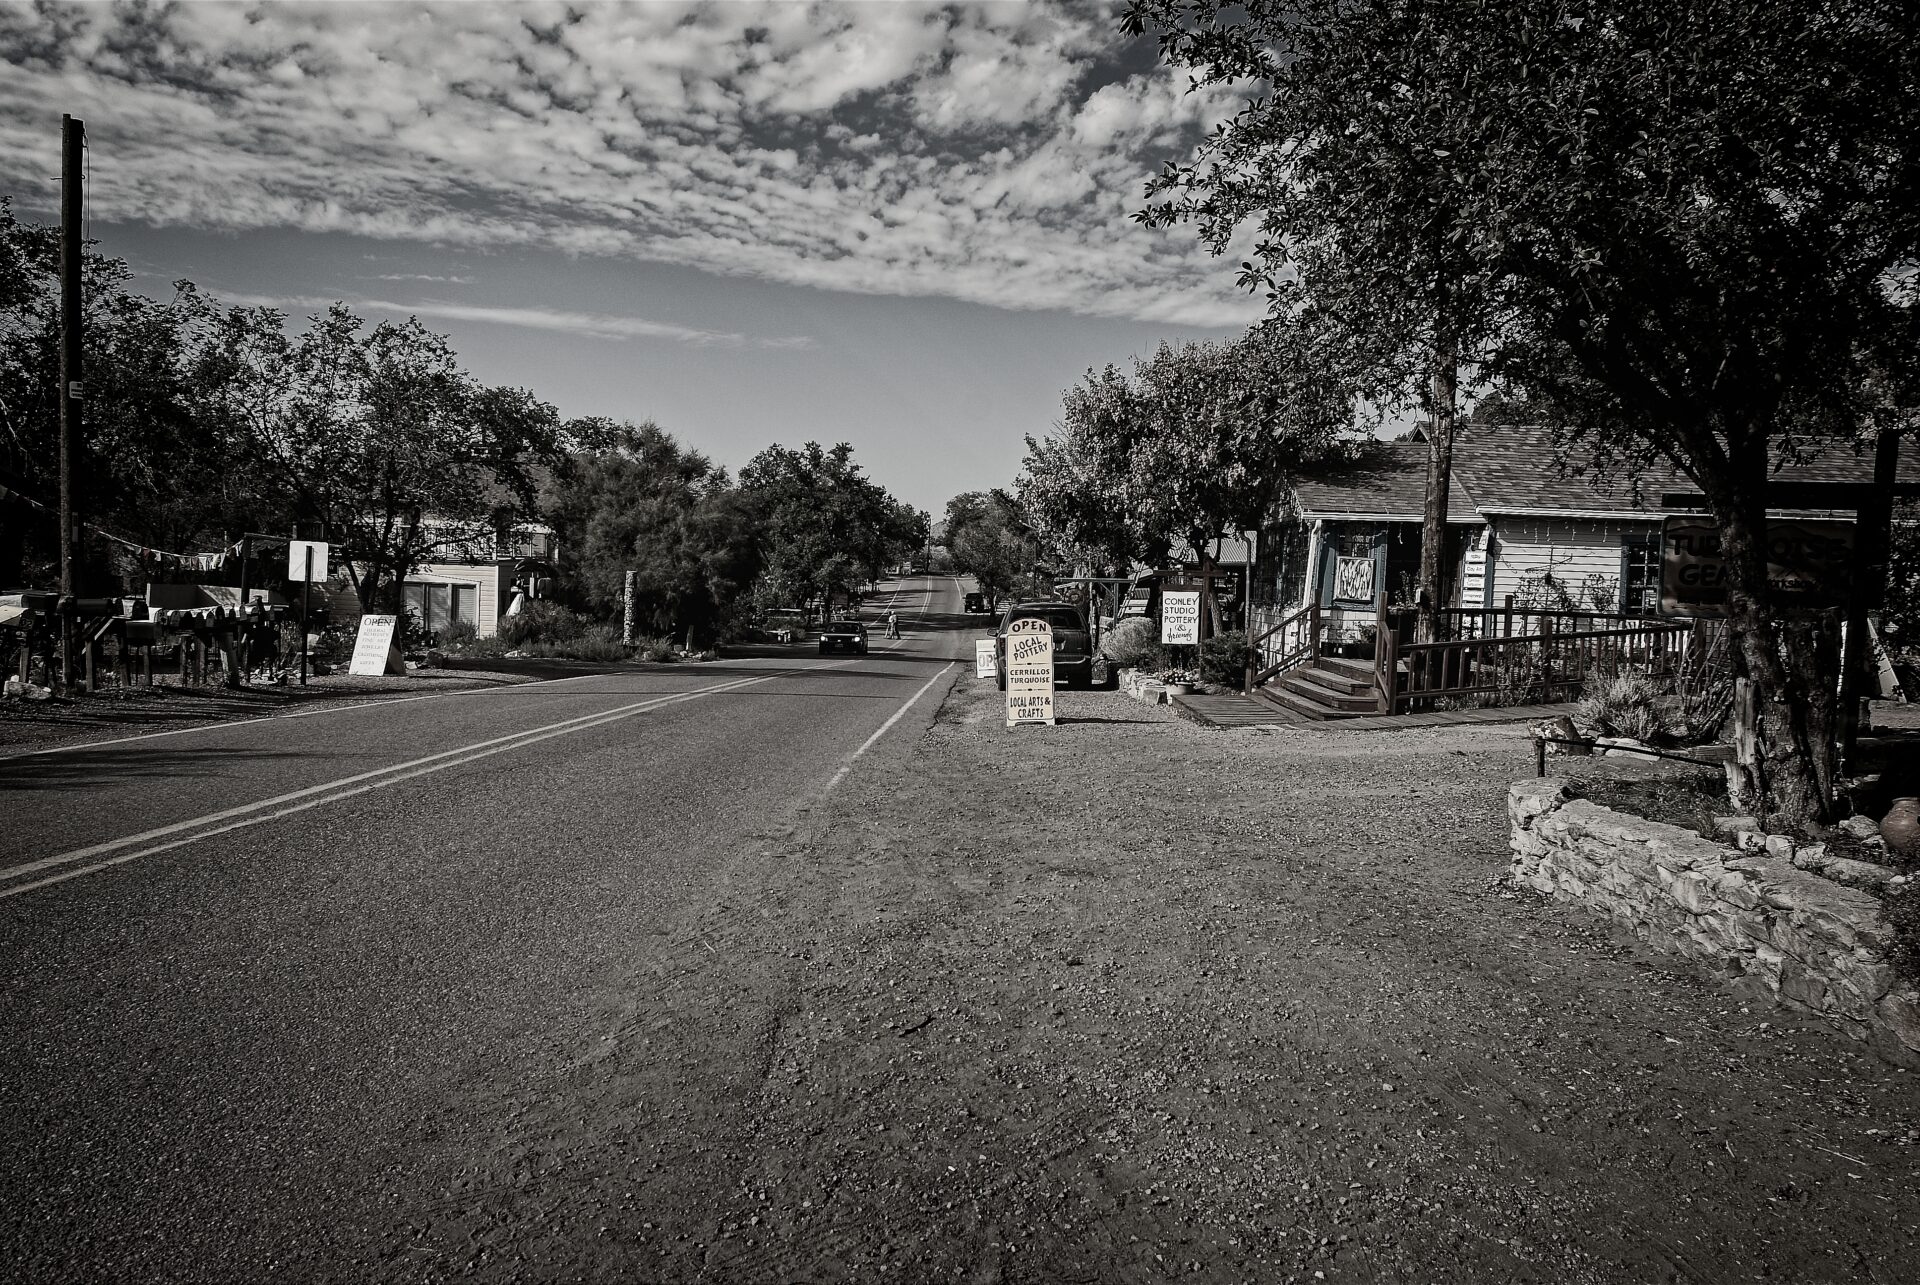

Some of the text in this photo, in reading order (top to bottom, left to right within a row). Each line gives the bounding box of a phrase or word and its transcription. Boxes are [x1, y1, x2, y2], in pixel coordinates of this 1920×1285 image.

[1165, 596, 1200, 606] CONLEY
[364, 617, 393, 626] OPEN
[1164, 615, 1199, 623] POTTERY
[1012, 620, 1047, 632] OPEN
[1014, 636, 1042, 652] LOCAL
[1013, 642, 1048, 661] POTTERY
[1010, 697, 1051, 707] LOCAL ARTS &
[1018, 709, 1044, 718] CRAFTS
